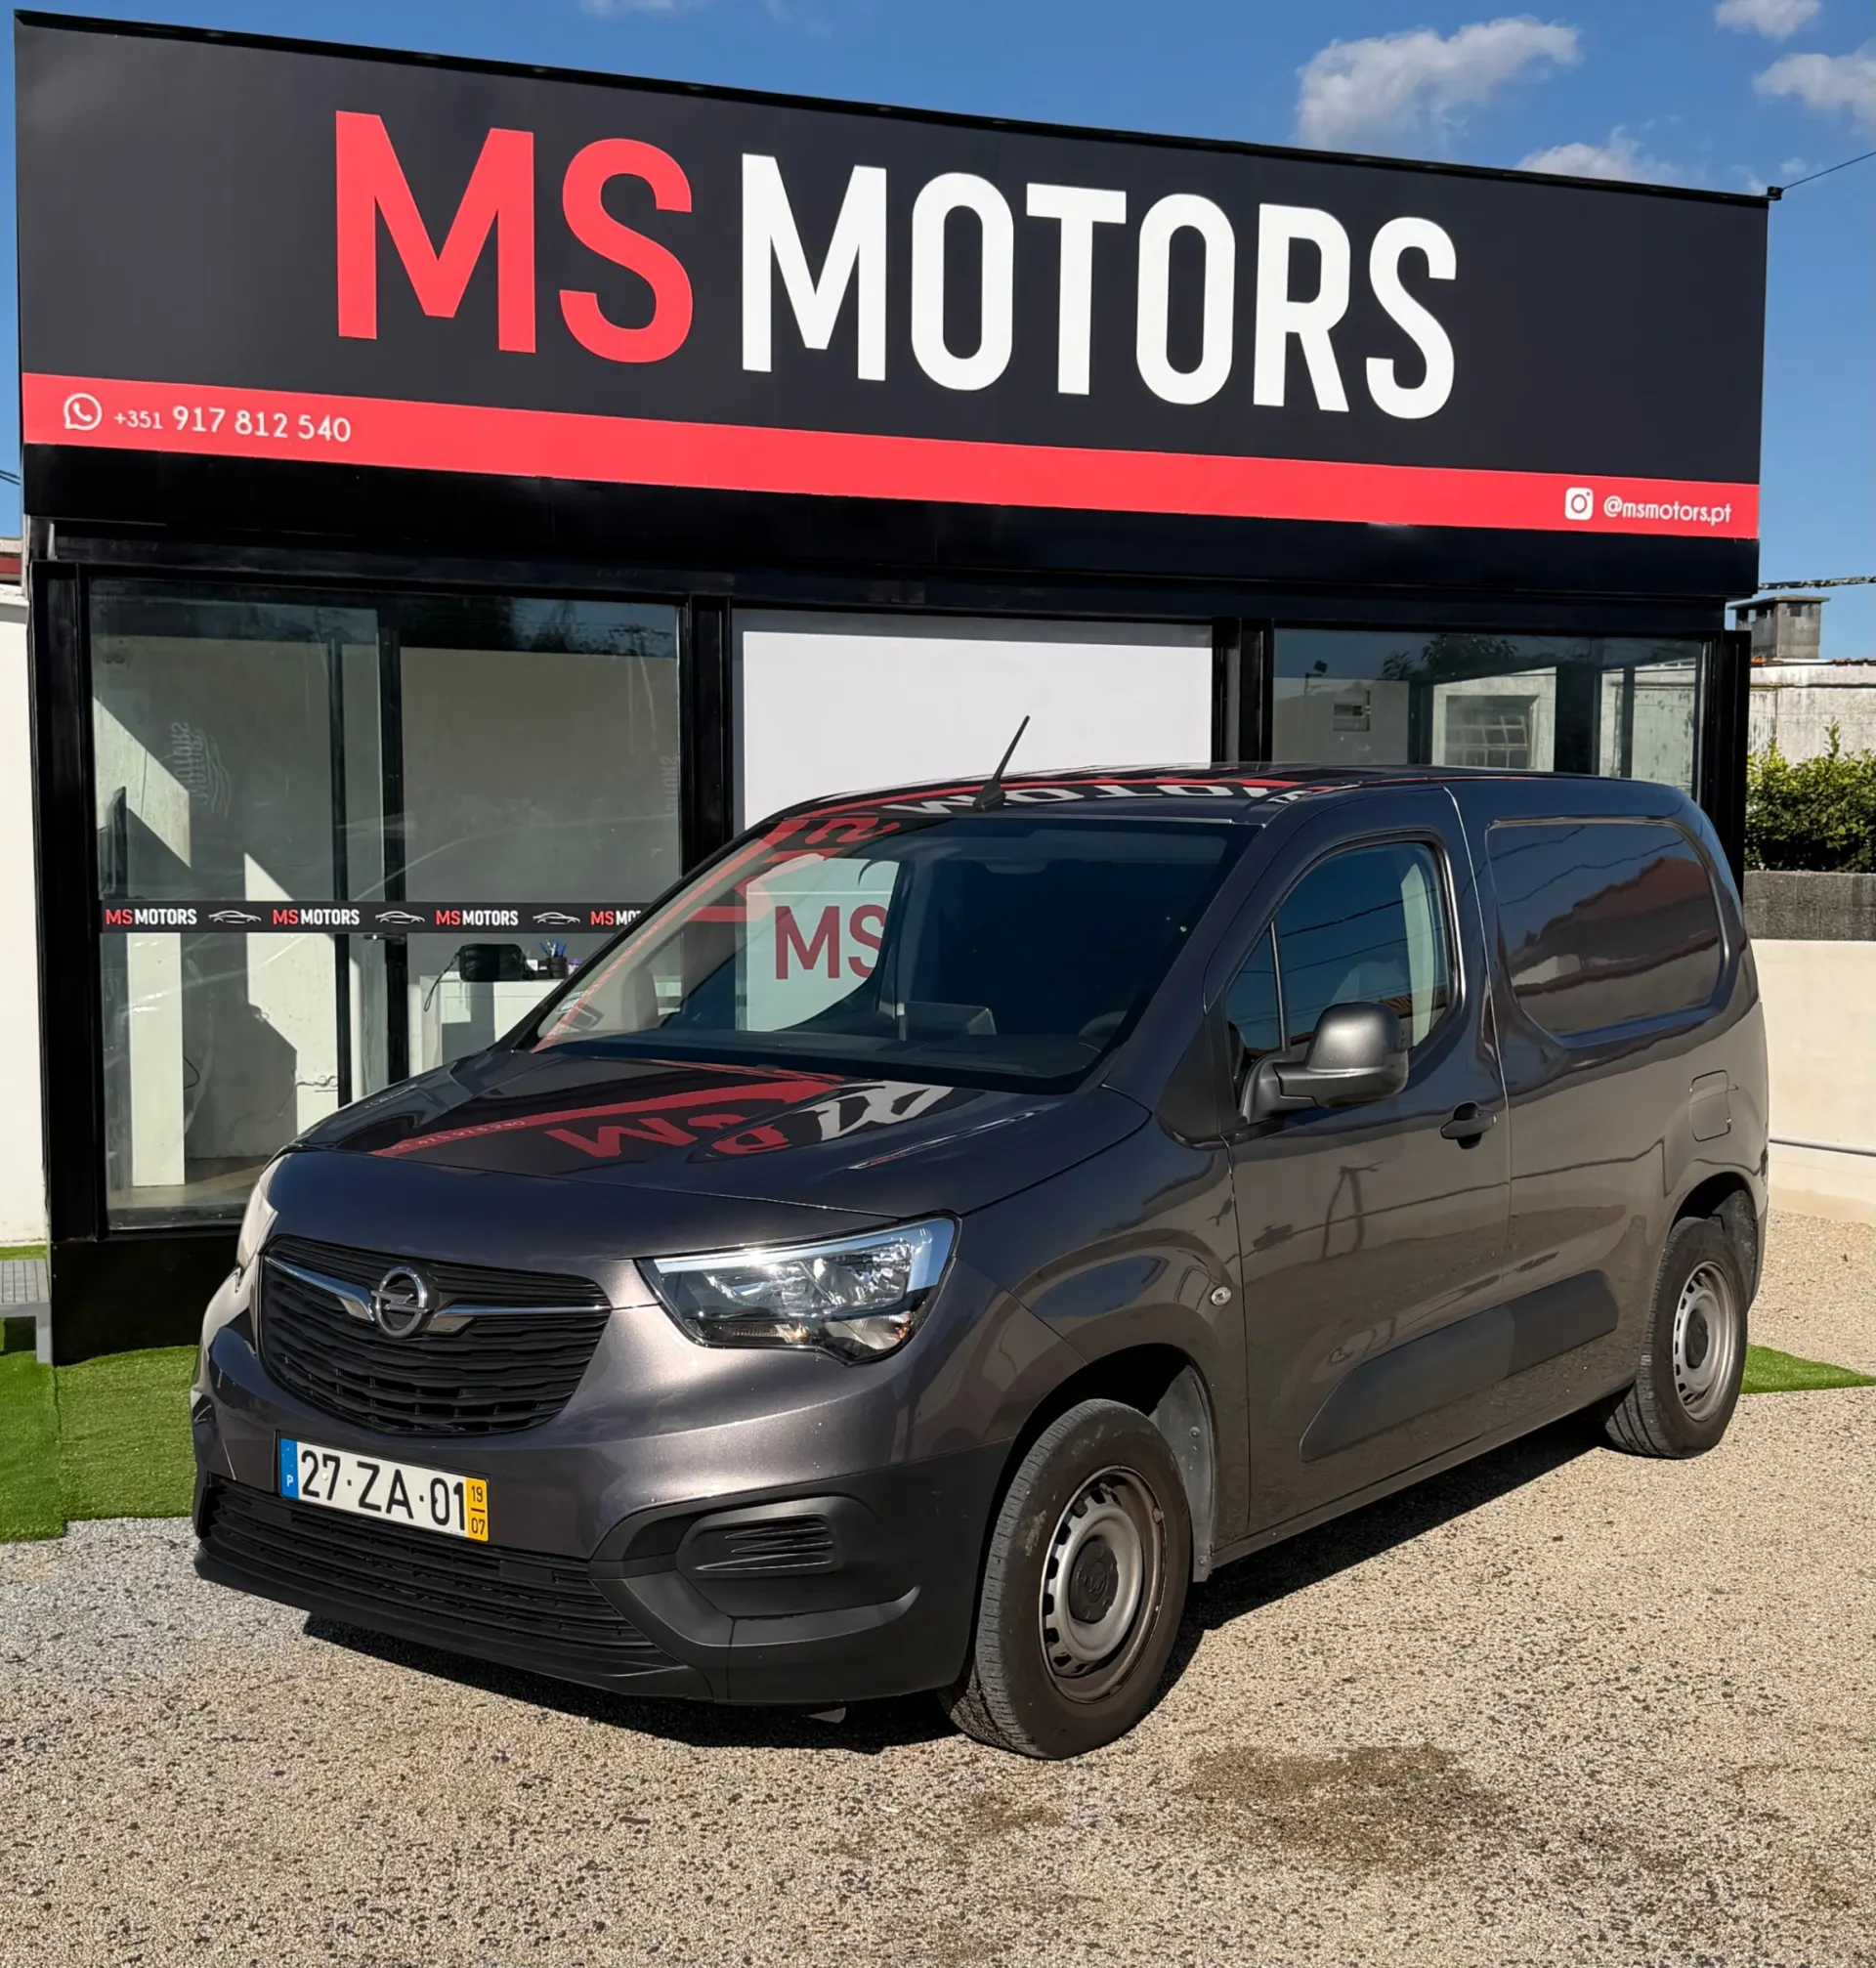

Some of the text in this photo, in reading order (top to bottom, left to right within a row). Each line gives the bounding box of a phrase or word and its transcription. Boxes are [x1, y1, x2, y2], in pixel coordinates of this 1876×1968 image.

[335, 110, 1457, 420] MS MOTORS
[114, 406, 352, 443] +351 917 812 540
[1603, 495, 1732, 526] @msmotors.pt
[105, 908, 197, 925] MS MOTORS
[272, 908, 361, 925] MS MOTORS
[435, 910, 519, 926] MS MOTORS
[590, 910, 642, 926] MS MO
[285, 1474, 294, 1487] P
[471, 1484, 484, 1503] 19
[470, 1518, 486, 1536] 07
